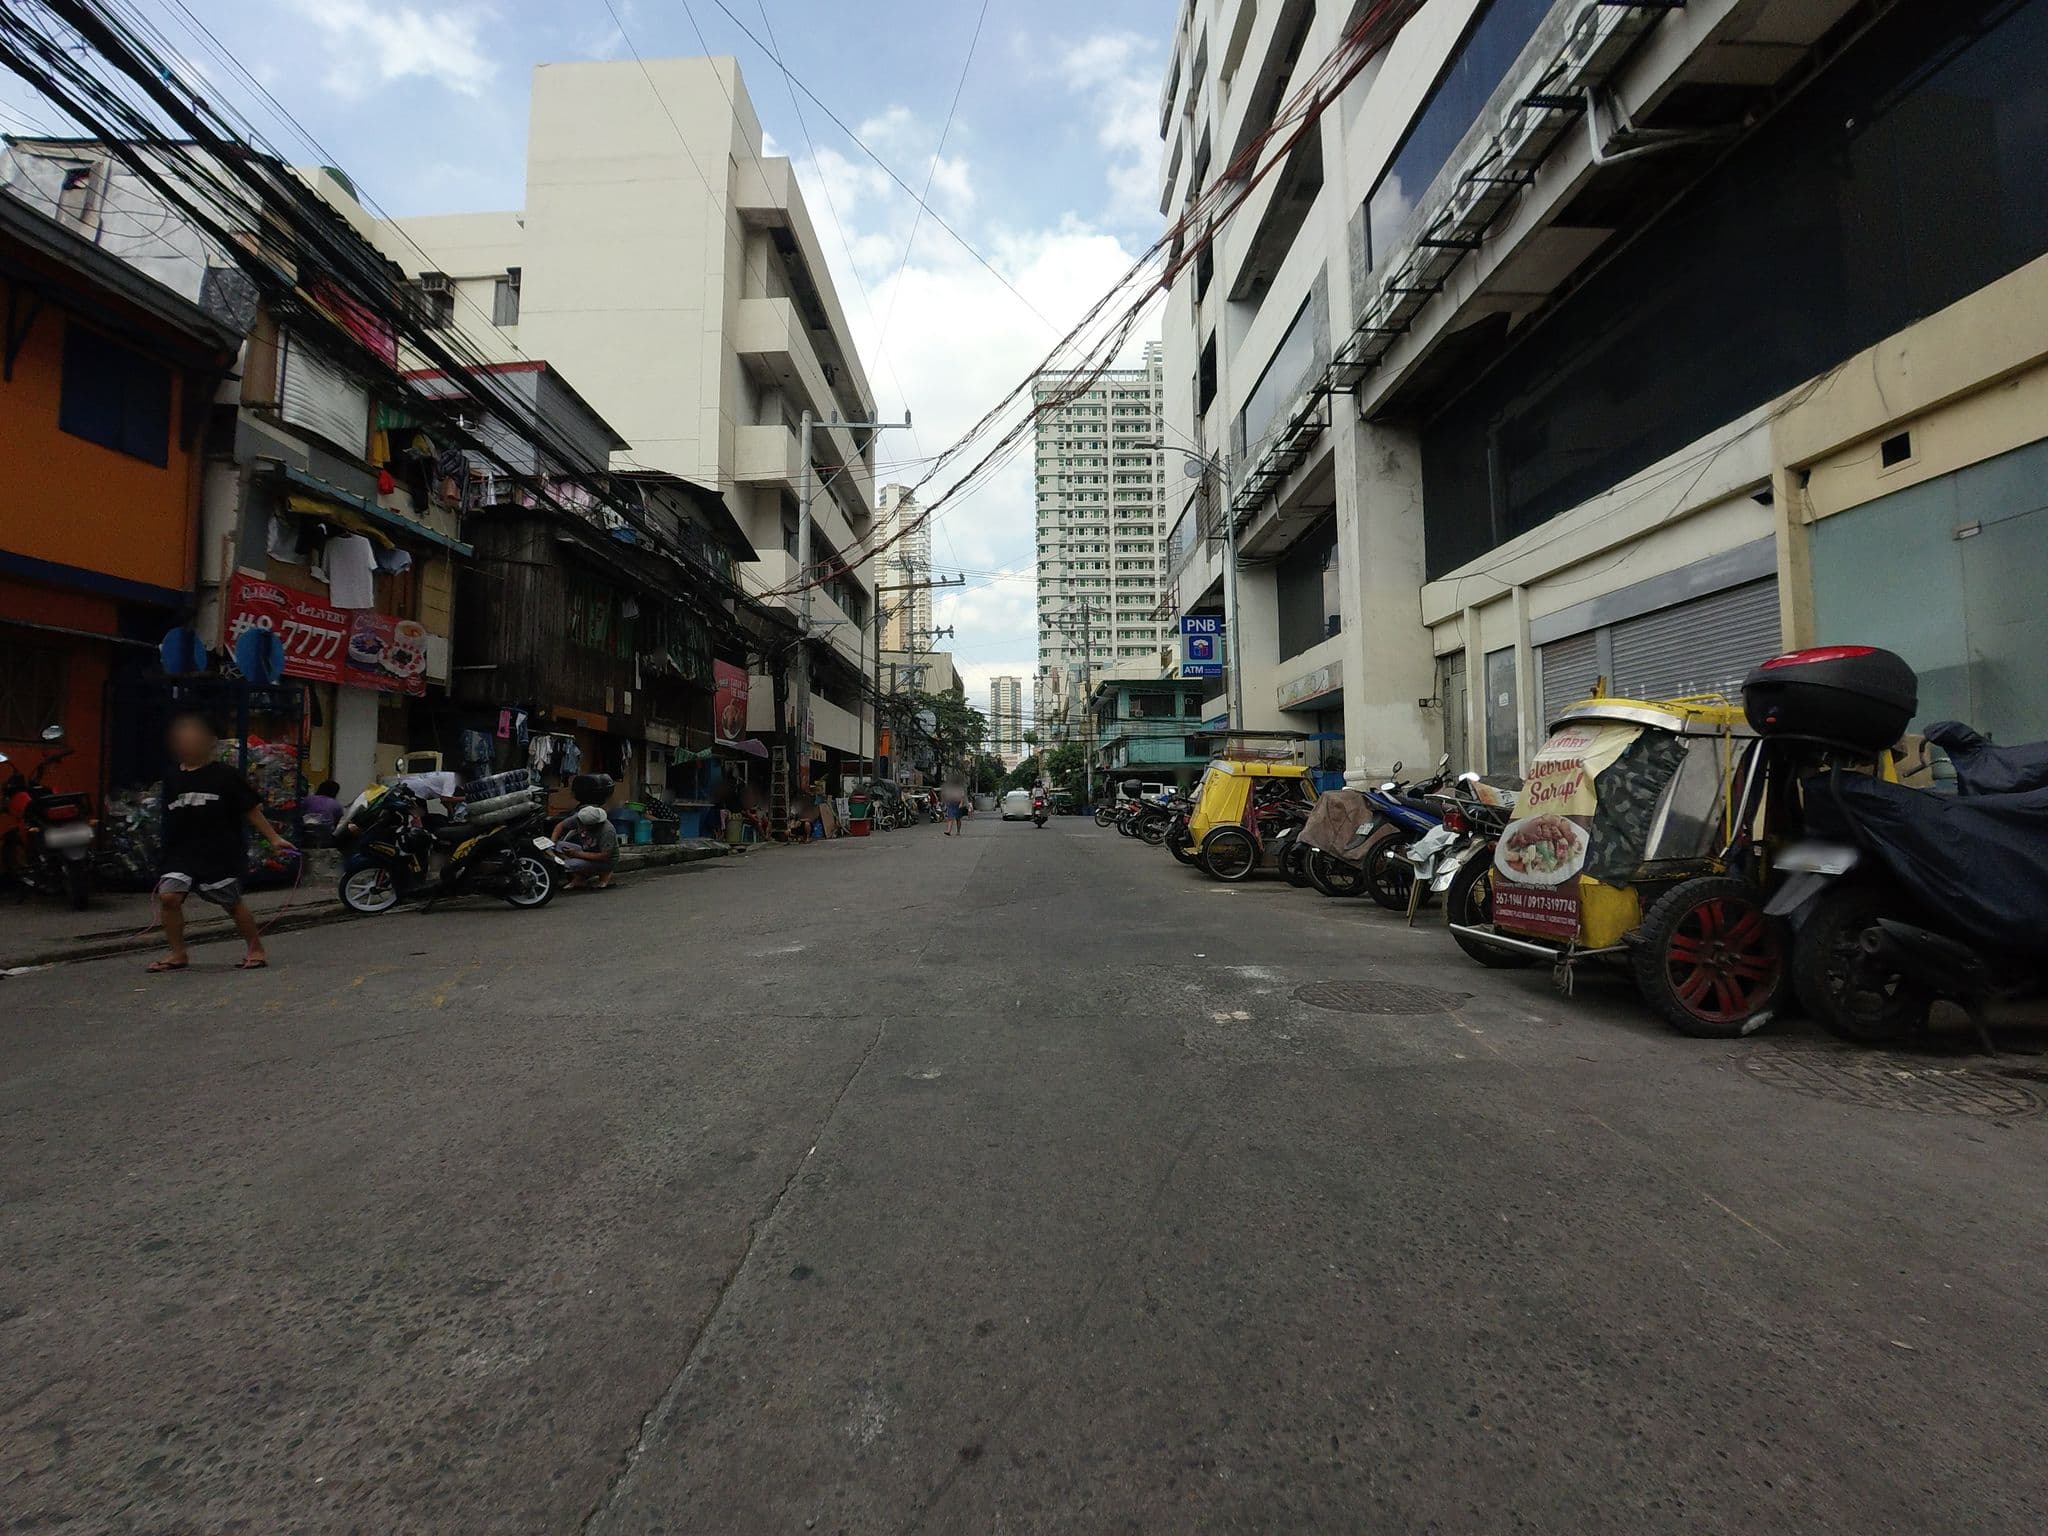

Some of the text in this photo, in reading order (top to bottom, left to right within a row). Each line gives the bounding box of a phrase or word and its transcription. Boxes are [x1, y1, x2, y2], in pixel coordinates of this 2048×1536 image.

[1186, 619, 1216, 632] PNB
[1184, 665, 1204, 675] ATM
[1530, 772, 1584, 806] Sarap!
